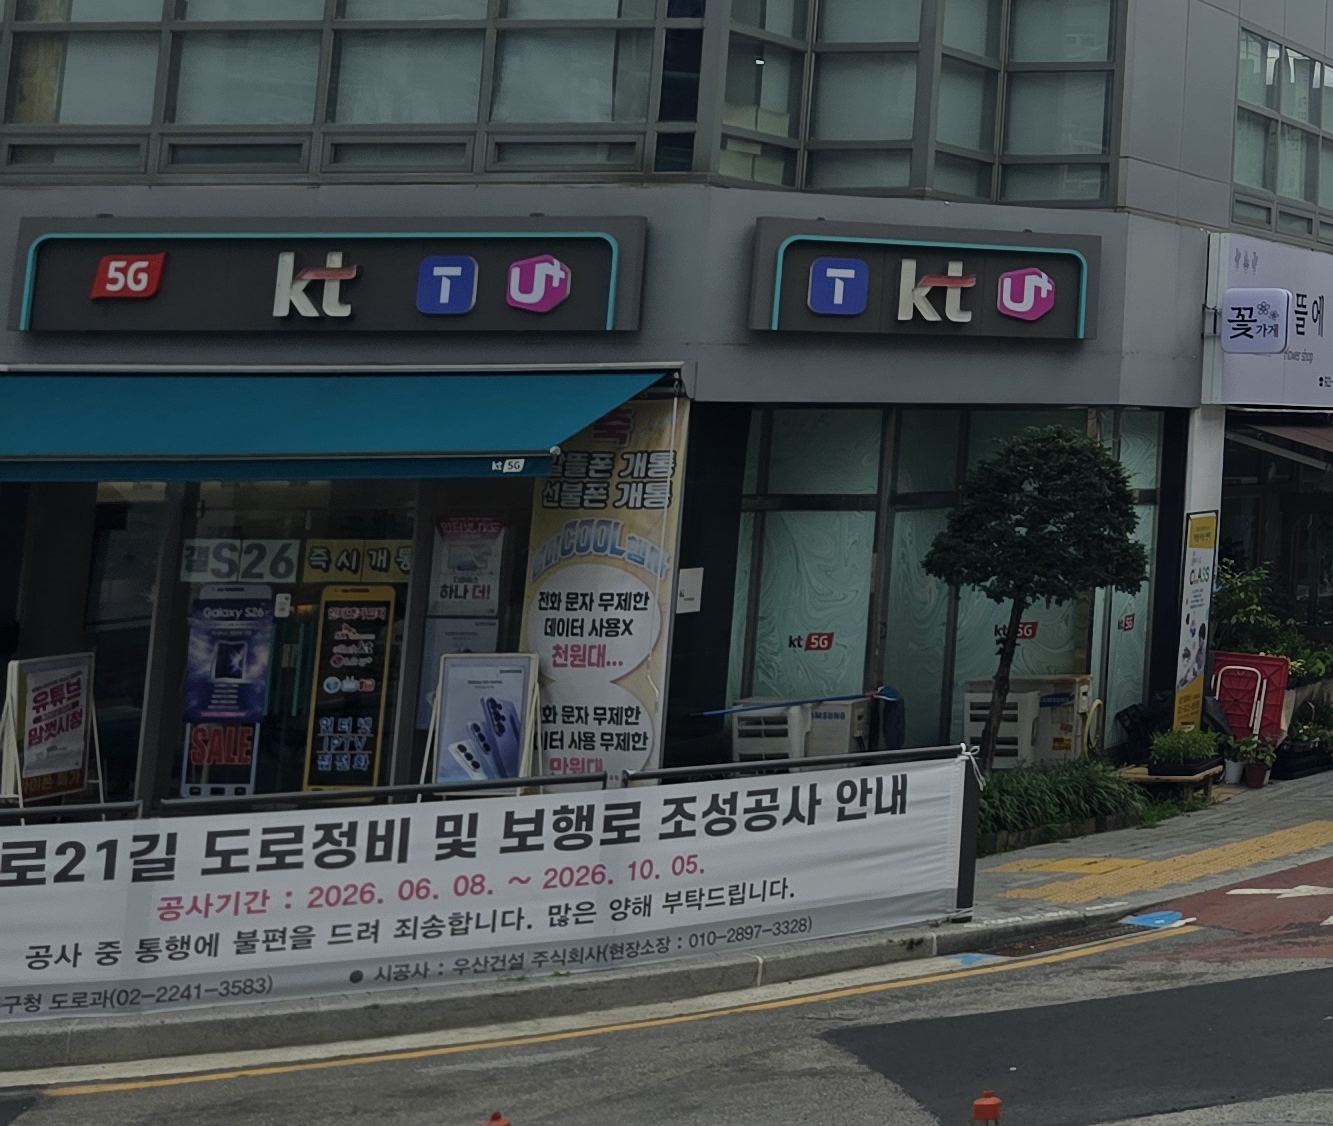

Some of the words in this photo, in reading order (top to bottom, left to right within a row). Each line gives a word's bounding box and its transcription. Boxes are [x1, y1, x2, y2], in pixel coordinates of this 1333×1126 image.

[104, 261, 150, 293] 5G
[272, 252, 357, 317] kt
[899, 258, 976, 323] kt
[1294, 292, 1324, 338] 뜰에
[492, 461, 502, 471] kt
[507, 461, 521, 470] 5G
[543, 482, 608, 508] 선불폰
[614, 482, 670, 508] 개통
[185, 542, 295, 580] 갤S26
[203, 607, 242, 619] Galaxy
[245, 607, 264, 618] S26
[538, 592, 561, 612] 전화
[566, 592, 594, 612] 문자
[598, 591, 649, 612] 무제한
[544, 619, 584, 636] 데이터
[588, 619, 633, 637] 사용X
[789, 636, 803, 649] kt
[810, 635, 829, 649] 5G
[191, 728, 252, 765] SALE
[0, 832, 178, 888] 로21길
[201, 817, 411, 876] 도로정비
[434, 812, 479, 862] 및
[500, 802, 641, 854] 보행로
[658, 783, 822, 840] 조성공사
[836, 773, 907, 823] 안내
[157, 888, 270, 922] 공사기간
[307, 883, 384, 910] 2026.
[398, 878, 439, 901] 06.
[453, 874, 494, 896] 08.
[544, 865, 614, 889] 2026.
[628, 861, 660, 882] 10.
[672, 854, 705, 877] 05.
[26, 942, 82, 970] 공사
[95, 940, 122, 964] 중
[135, 932, 220, 964] 통행에
[233, 925, 315, 955] 불편을
[327, 918, 380, 946] 드려
[394, 907, 533, 941] 죄송합니다.
[548, 900, 597, 928] 많은
[609, 895, 652, 921] 양해
[662, 877, 795, 913] 부탁드립니다.
[5, 994, 41, 1013] 구청
[51, 975, 273, 1011] 도로과(02-2241-3583)
[374, 962, 430, 983] 시공사
[452, 954, 524, 975] 우산건설
[531, 934, 671, 968] 주식회사(현장소장
[688, 916, 812, 948] 010-2897-3328)
